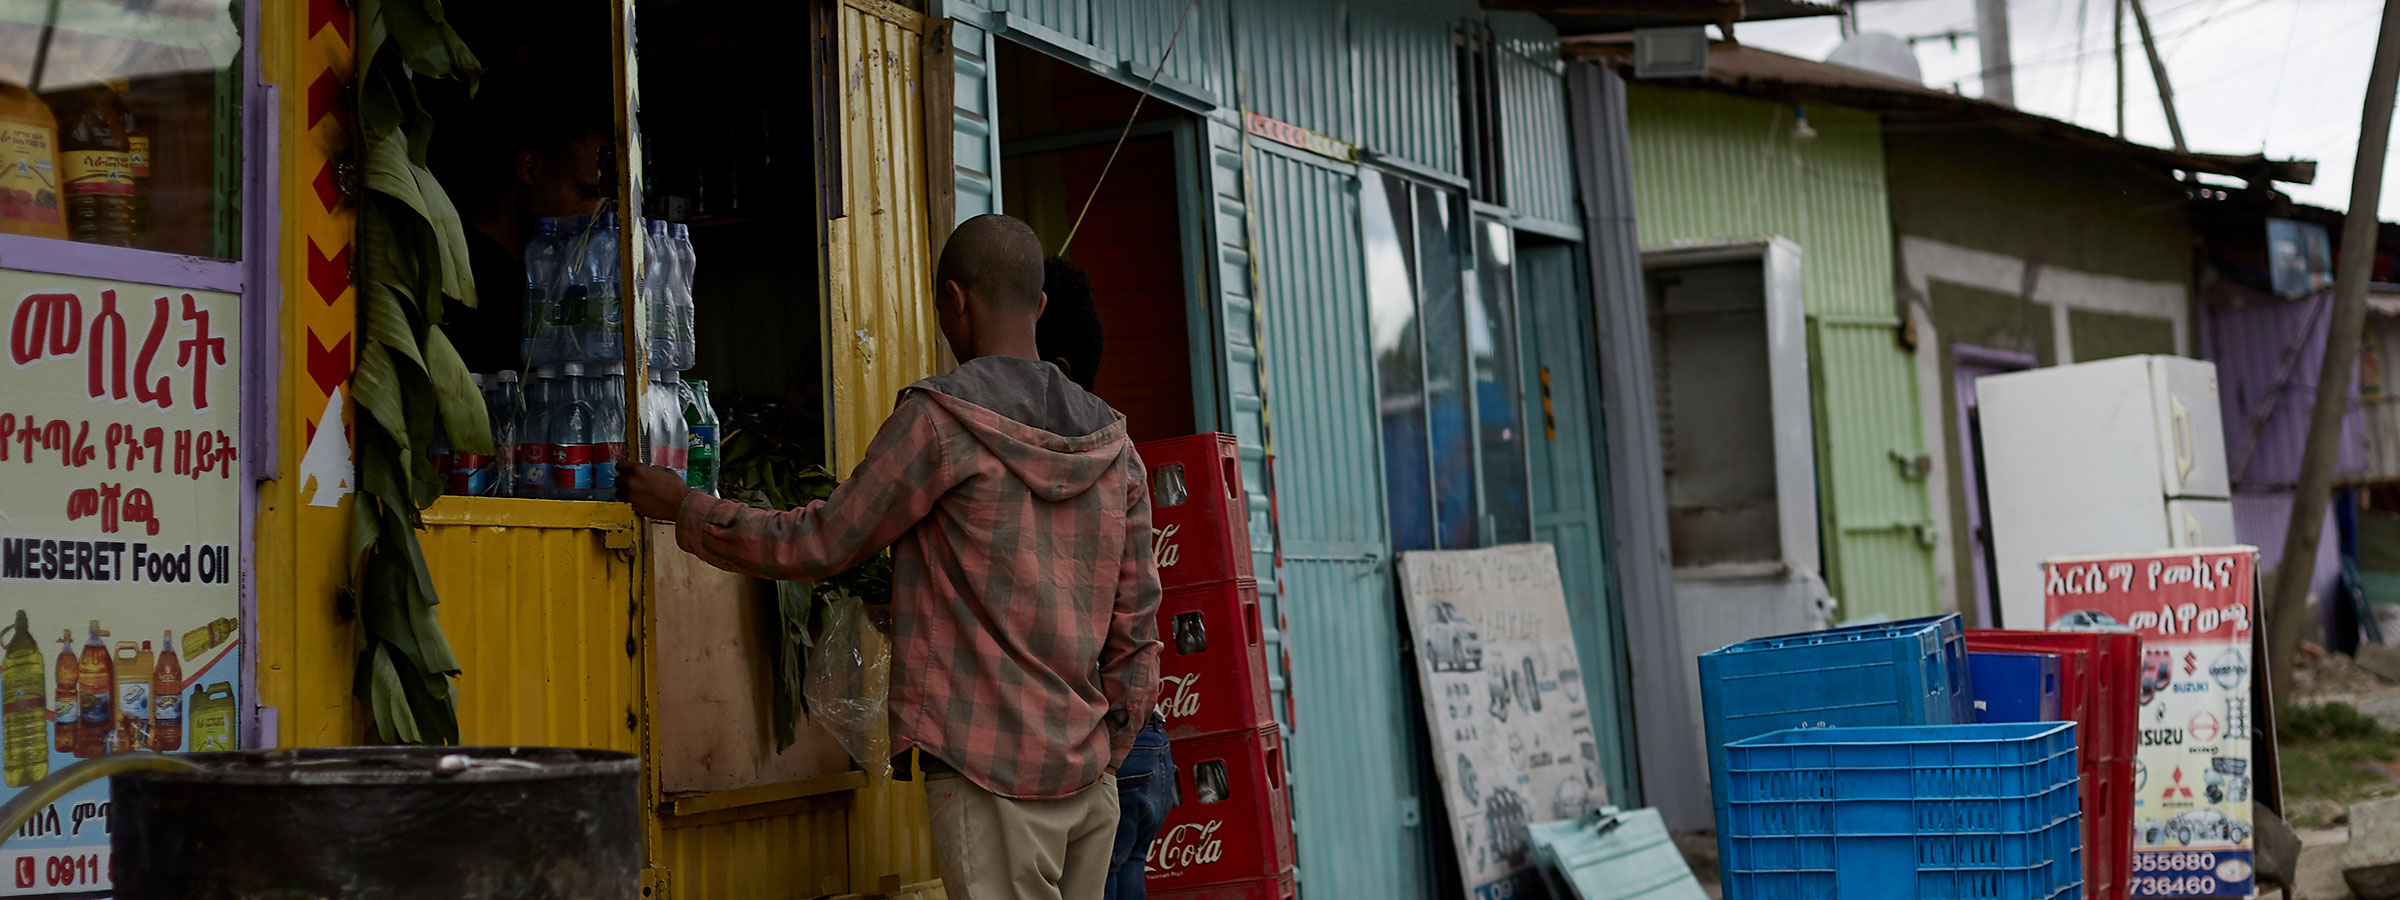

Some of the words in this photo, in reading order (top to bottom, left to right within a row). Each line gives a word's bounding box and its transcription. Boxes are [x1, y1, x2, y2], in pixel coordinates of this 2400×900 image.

[10, 289, 226, 410] መሰረት
[0, 413, 95, 467] የተጣራ
[174, 429, 237, 480] ዘይት
[67, 482, 160, 536] መሸጫ
[3, 538, 126, 581] MESERET
[132, 543, 191, 583] Food
[2148, 556, 2236, 592] የመኪና
[2129, 602, 2251, 635] መለዋወጫ
[2173, 682, 2209, 693] SUZUKI
[2139, 728, 2183, 746] ISUZU
[46, 853, 98, 887] 0911
[2130, 875, 2216, 895] 736460
